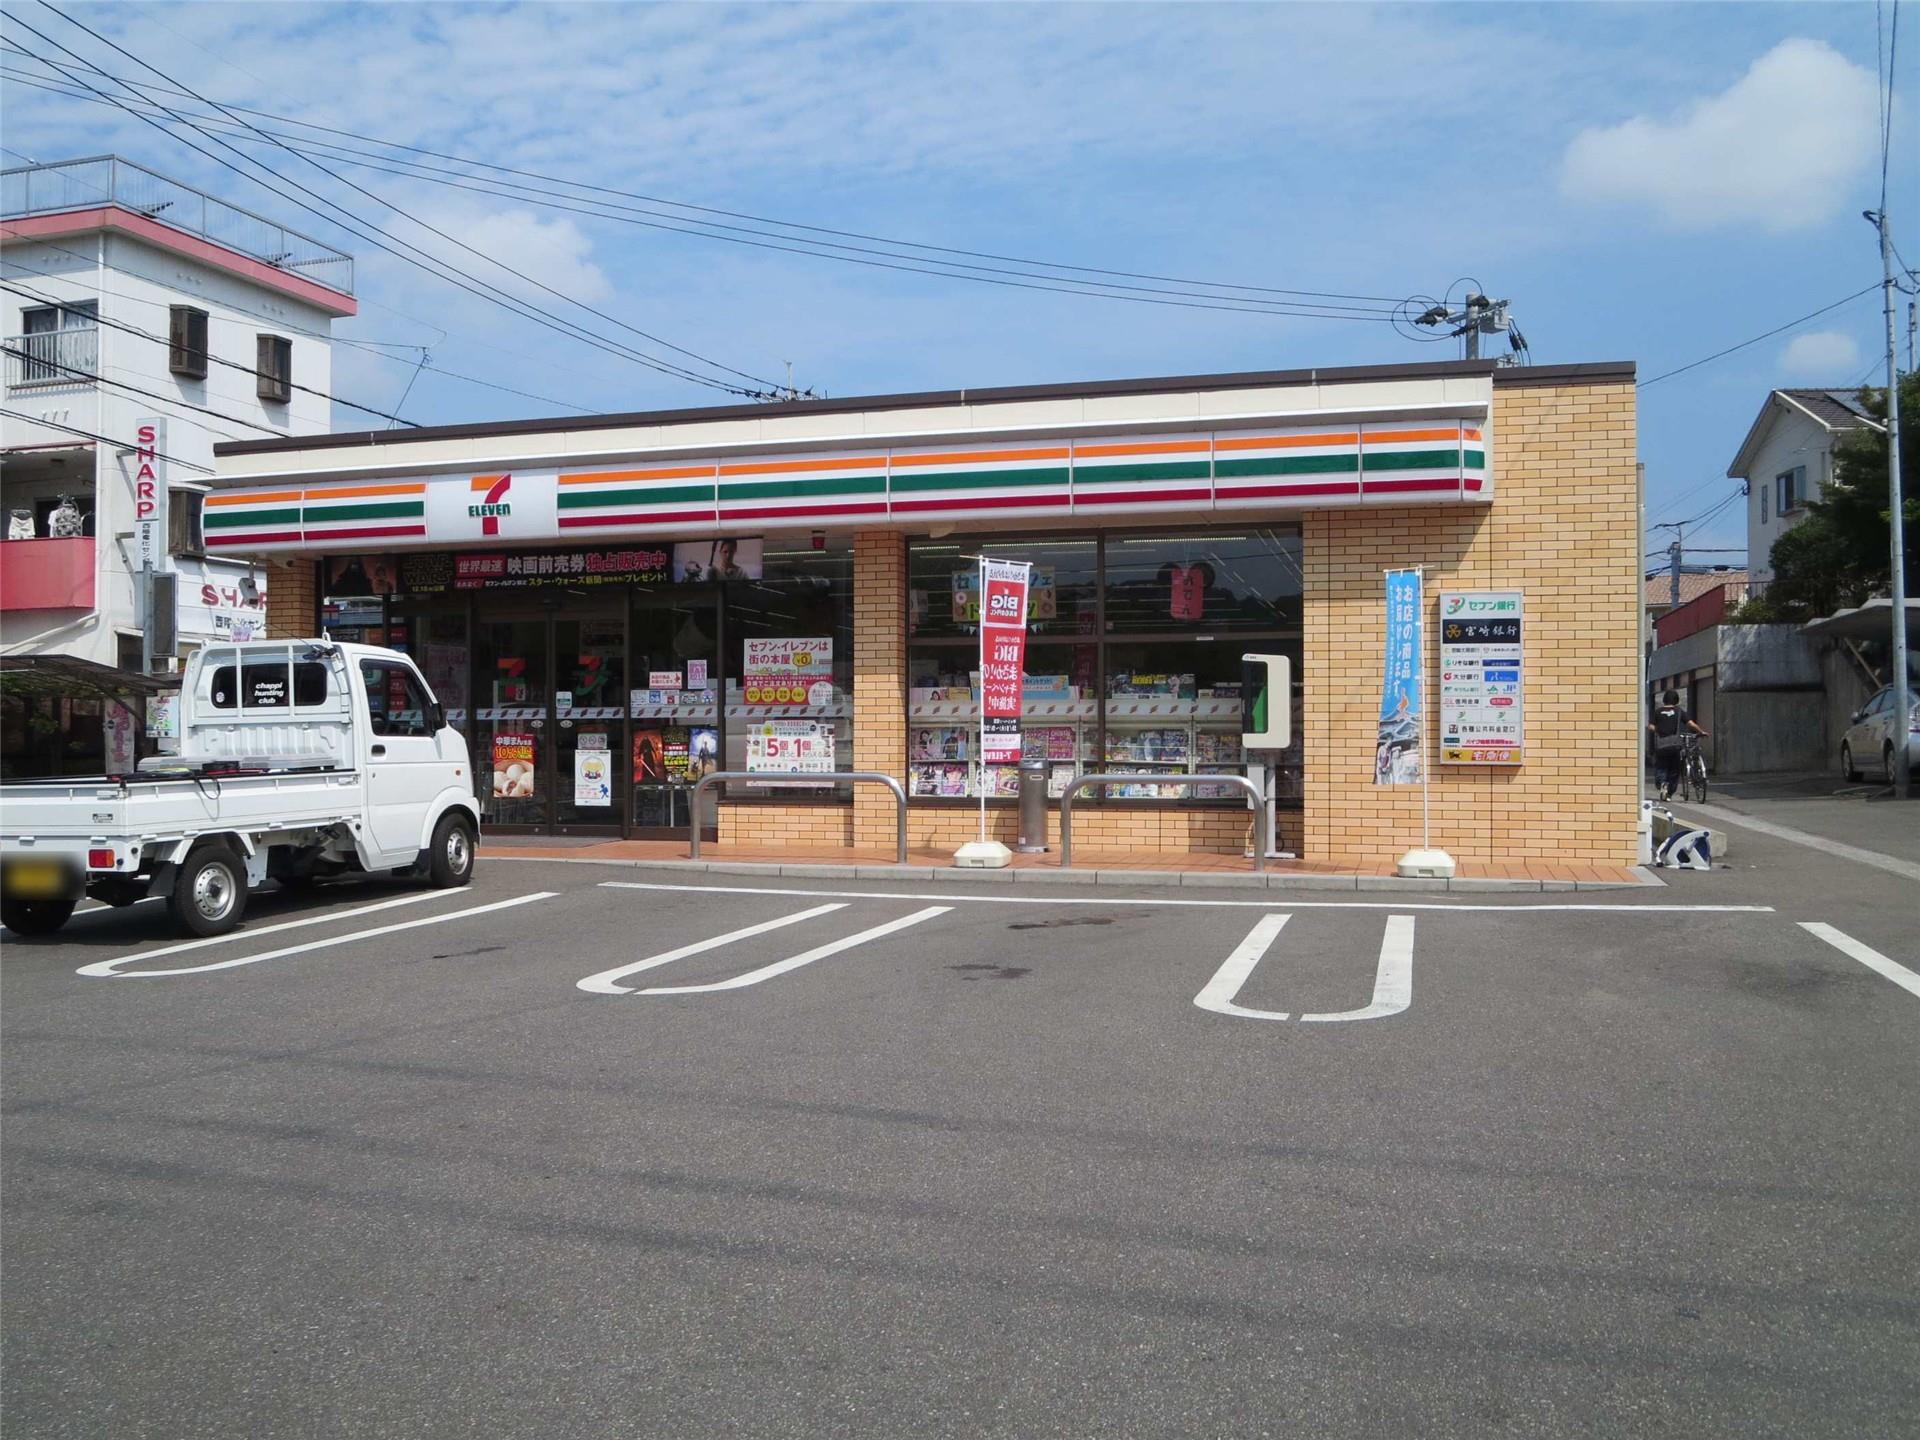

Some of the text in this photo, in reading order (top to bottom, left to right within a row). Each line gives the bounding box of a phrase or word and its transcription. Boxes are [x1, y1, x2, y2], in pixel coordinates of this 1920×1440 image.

[137, 426, 156, 519] SHARP
[1469, 601, 1516, 611] セブン銀行
[1465, 625, 1517, 636] 宮崎銀行
[749, 654, 791, 665] 街の本屋
